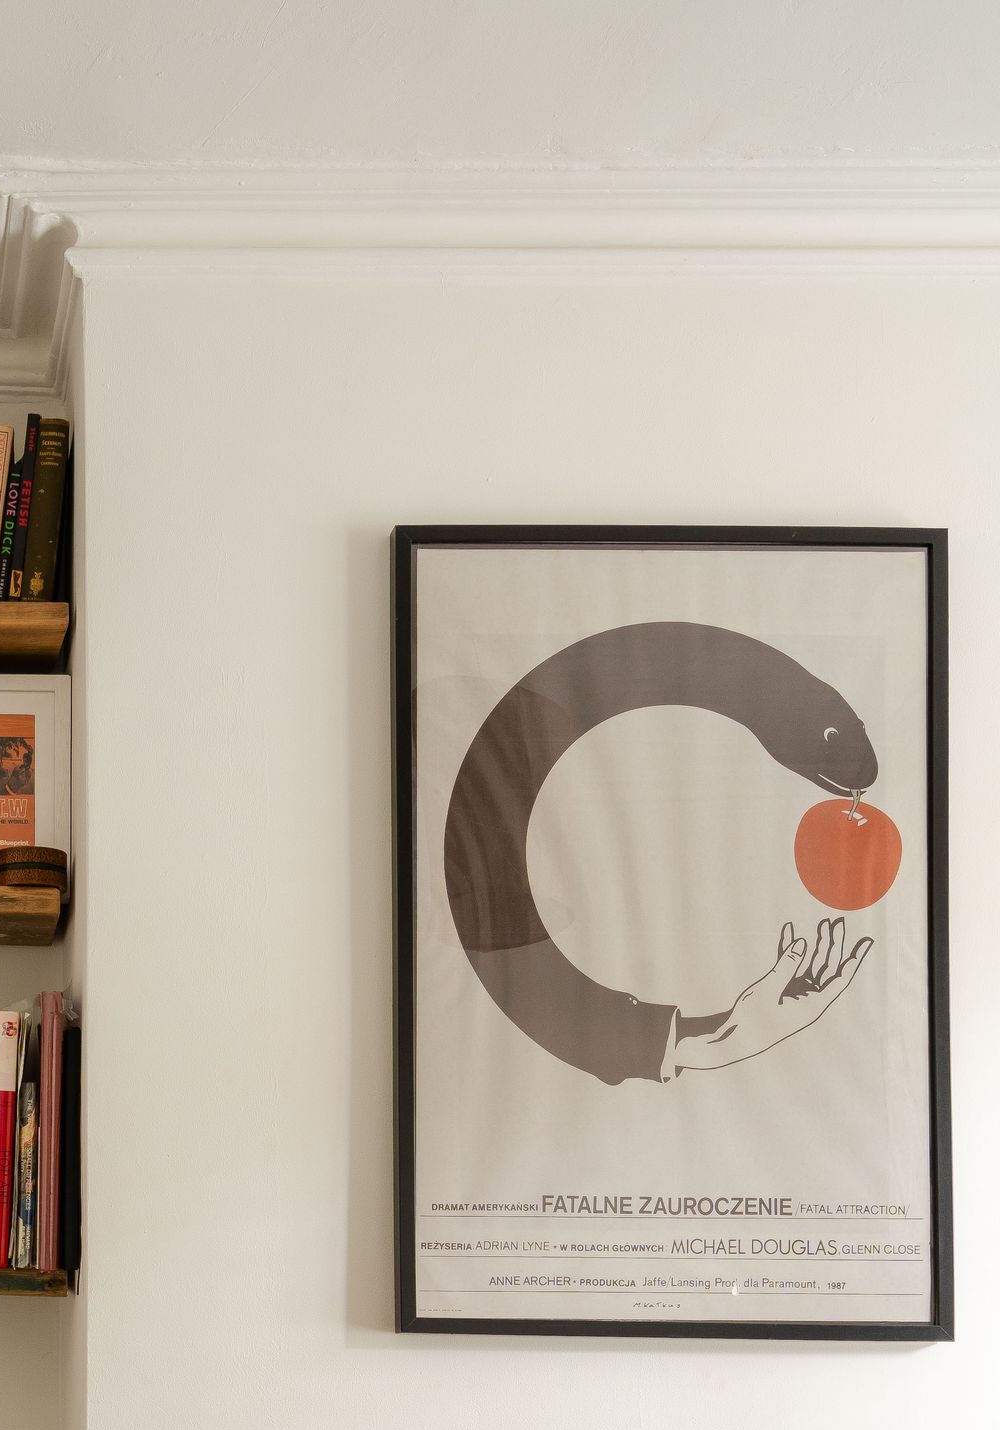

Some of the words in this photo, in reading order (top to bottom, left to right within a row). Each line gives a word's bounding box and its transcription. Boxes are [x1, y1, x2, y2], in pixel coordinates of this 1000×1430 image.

[7, 481, 20, 517] LOVE
[18, 480, 32, 527] FETISH
[1, 520, 15, 555] DICK
[431, 1202, 470, 1212] DRAMAT
[471, 1201, 539, 1212] AMERYKAŃSKI
[541, 1194, 633, 1215] FATALNE
[638, 1196, 793, 1216] ZAUROCZENIE
[475, 1240, 519, 1251] ADRIAN
[522, 1241, 550, 1252] LYNE
[559, 1244, 569, 1252] W
[570, 1244, 610, 1253] ROLACH
[670, 1238, 746, 1255] MICHAEL
[841, 1243, 881, 1255] GLENN
[883, 1243, 922, 1255] CLOSE
[488, 1275, 521, 1286] ANNE
[522, 1276, 571, 1287] ARCHER
[579, 1278, 636, 1288] PRODUKCJA
[642, 1275, 711, 1289] Jaffe/Lansing
[743, 1278, 759, 1288] dla
[826, 1281, 847, 1290] 1987
